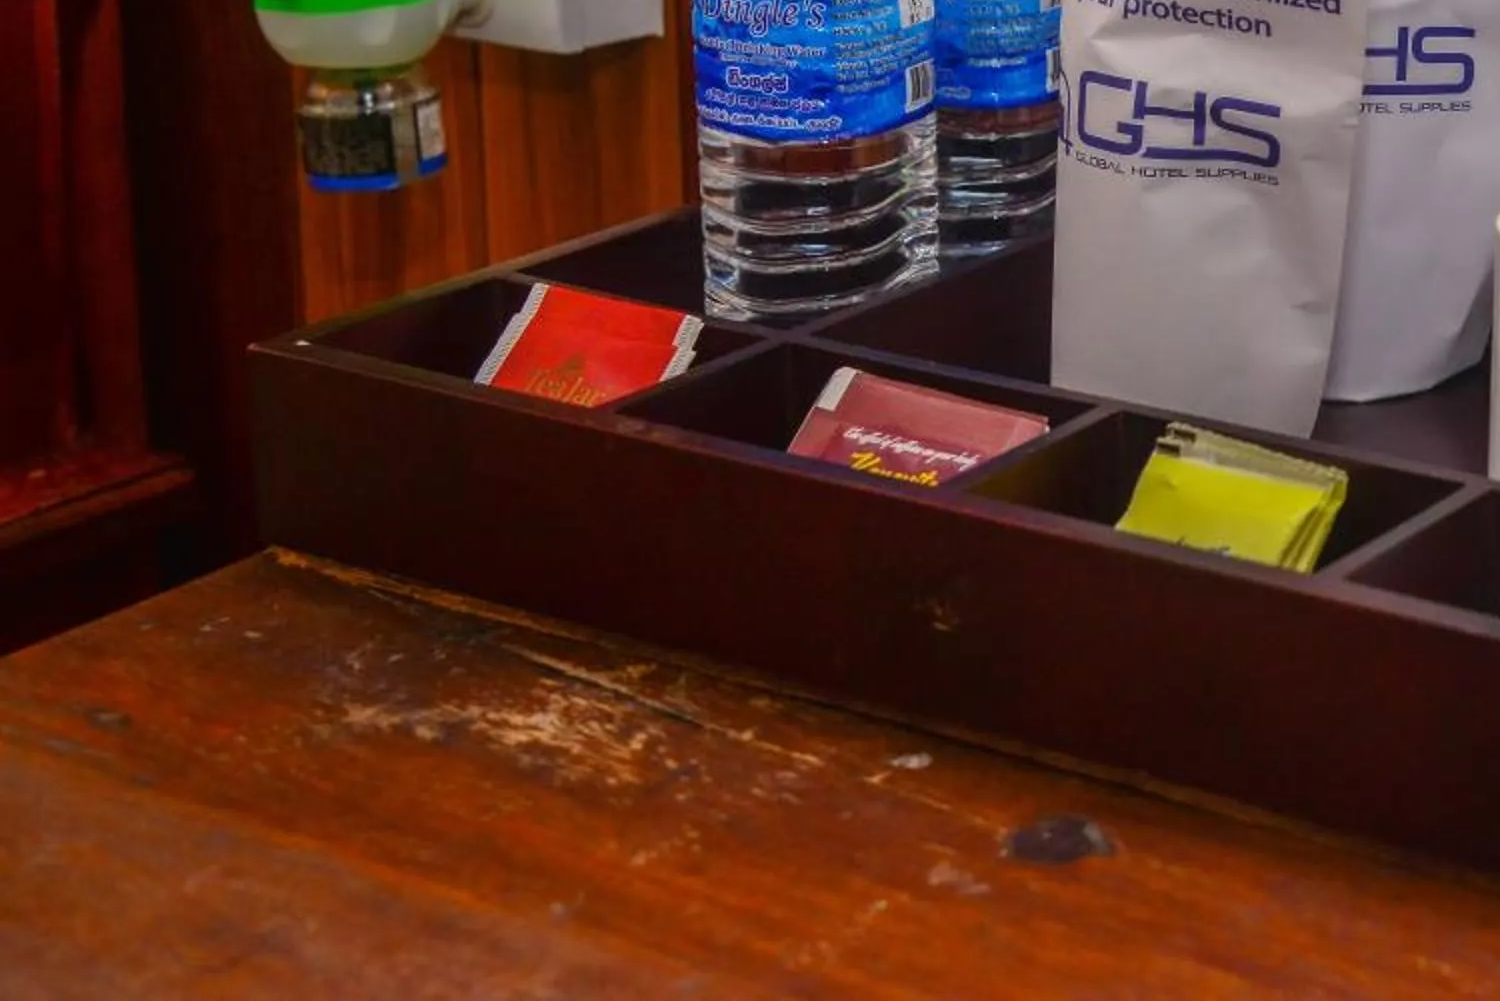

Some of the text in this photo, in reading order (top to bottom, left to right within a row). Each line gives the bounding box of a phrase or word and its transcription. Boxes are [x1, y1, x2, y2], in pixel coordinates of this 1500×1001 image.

[1362, 26, 1476, 95] HS
[1076, 69, 1282, 169] GHS
[1399, 100, 1472, 113] SUPPLIES
[1074, 150, 1280, 187] GLOBAL HOTEL SUPPLIES
